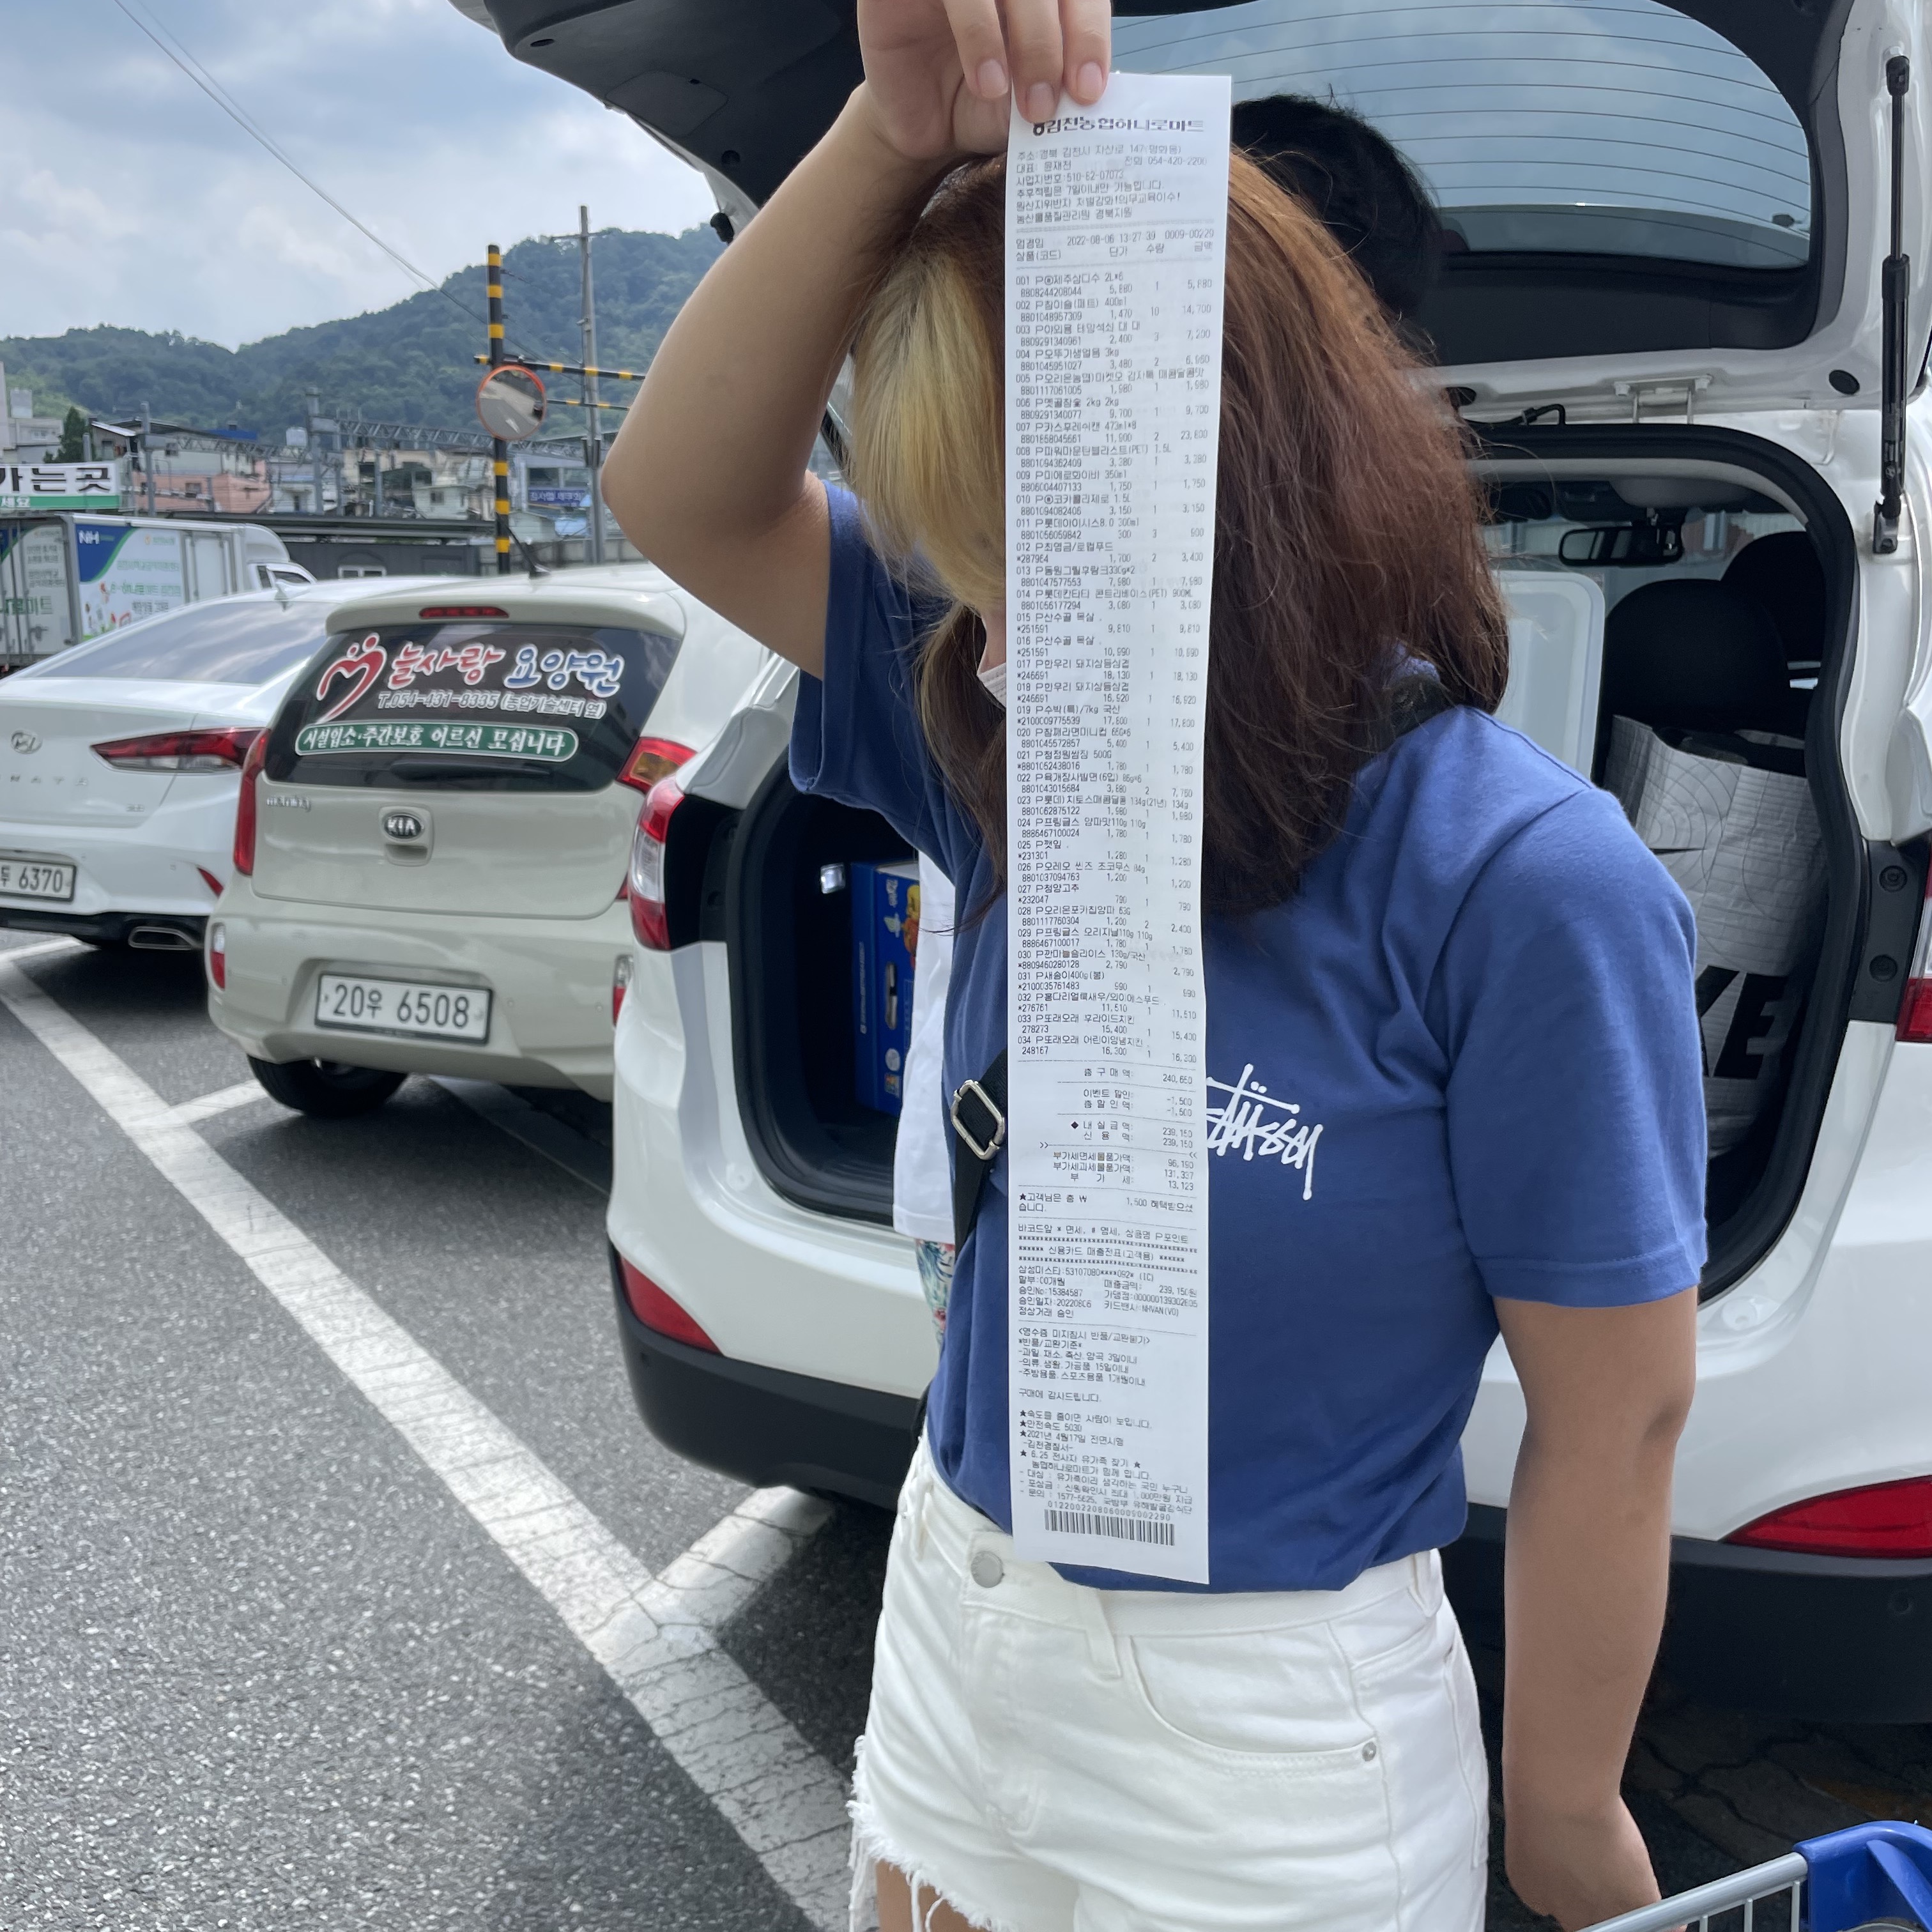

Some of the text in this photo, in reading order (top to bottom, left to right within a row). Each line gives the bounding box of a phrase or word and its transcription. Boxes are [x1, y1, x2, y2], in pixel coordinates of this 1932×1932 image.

[1016, 275, 1029, 286] 001
[1020, 286, 1082, 298] 8808244208044
[1016, 300, 1031, 310] 002
[1020, 306, 1160, 323] 8801048957309 1,470 10
[1016, 325, 1031, 335] 003
[1109, 334, 1133, 344] 2,400
[1016, 349, 1030, 359] 004
[1020, 360, 1082, 371] 8801045951027
[1016, 373, 1031, 383] 005
[1016, 397, 1119, 408] 006 2kg 2kg
[1021, 410, 1082, 420] 8809291340077
[1109, 408, 1132, 419] 9,700
[1016, 422, 1031, 432] 007
[1016, 446, 1031, 456] 008
[1016, 470, 1031, 480] 009
[1110, 481, 1132, 491] 1,750
[1016, 494, 1031, 504] 010
[1109, 505, 1131, 516] 3,150
[1016, 518, 1030, 528] 011
[1021, 529, 1082, 539] 8801056059842
[1016, 542, 1031, 552] 012
[1016, 565, 1031, 576] 013
[1021, 577, 1082, 587] 8801047577553
[1016, 589, 1031, 599] 014
[1021, 600, 1081, 611] 8801056177294
[1016, 612, 1031, 622] 015
[1016, 635, 1031, 646] 016
[1016, 659, 1031, 669] 017
[388, 641, 625, 698] 늘사랑 요양원
[1103, 670, 1130, 680] 18,130
[1016, 682, 1031, 693] 018
[1016, 705, 1031, 715] 019
[1016, 727, 1031, 737] 020
[431, 725, 483, 749] 어르신
[487, 729, 566, 756] 모십니다
[1021, 739, 1080, 749] 8801045572857
[1107, 738, 1127, 748] 5,400
[1016, 750, 1030, 760] 021
[1107, 761, 1127, 770] 1,780
[1016, 773, 1031, 783] 022
[1022, 783, 1080, 794] 8801043015684
[1017, 795, 1031, 805] 023
[1022, 806, 1080, 816] 8801062875122
[387, 816, 417, 836] KIA
[1017, 818, 1031, 828] 024
[1022, 829, 1079, 838] 8886467100024
[1107, 828, 1128, 838] 1,780
[1017, 840, 1031, 850] 025
[1107, 850, 1127, 860] 1,280
[1017, 862, 1031, 871] 026
[1036, 862, 1070, 871] P오레오
[18, 866, 64, 893] 6370
[1022, 873, 1080, 883] 8801037094763
[1107, 873, 1127, 882] 1,200
[1018, 885, 1031, 894] 027
[1017, 907, 1031, 916] 028
[1022, 917, 1079, 927] 8801117760304
[1107, 916, 1127, 926] 1,200
[1018, 929, 1031, 937] 029
[1022, 938, 1127, 949] 8886467100017 1,780
[1018, 949, 1032, 959] 030
[1105, 960, 1128, 969] 2,790
[1018, 971, 1031, 980] 031
[1018, 993, 1031, 1002] 032
[332, 983, 470, 1029] 20우 6508
[1018, 1014, 1032, 1023] 033
[1022, 1025, 1049, 1034] 278273
[1101, 1024, 1128, 1034] 15,400
[1018, 1035, 1031, 1044] 034
[1021, 1045, 1048, 1056] 248167
[1064, 1423, 1082, 1432] 5030
